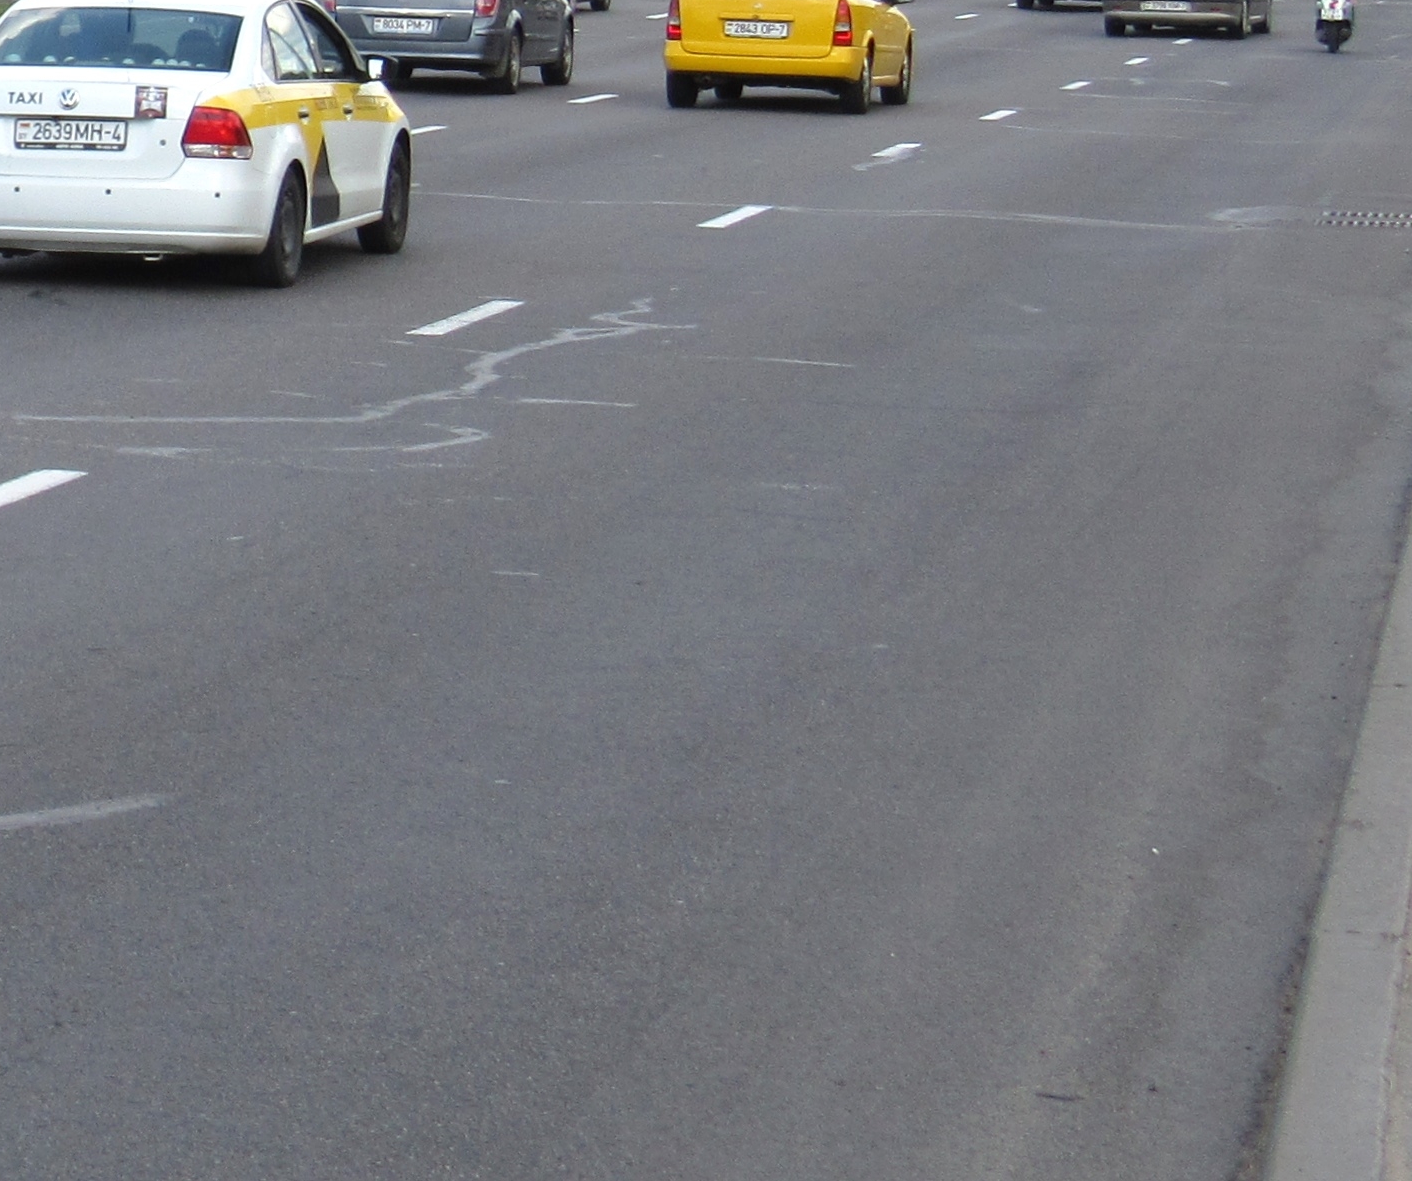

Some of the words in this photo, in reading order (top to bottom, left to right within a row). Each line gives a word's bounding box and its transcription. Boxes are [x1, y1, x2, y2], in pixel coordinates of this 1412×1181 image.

[382, 20, 404, 30] 8034
[7, 91, 43, 105] TAXI
[32, 122, 73, 140] 2639
